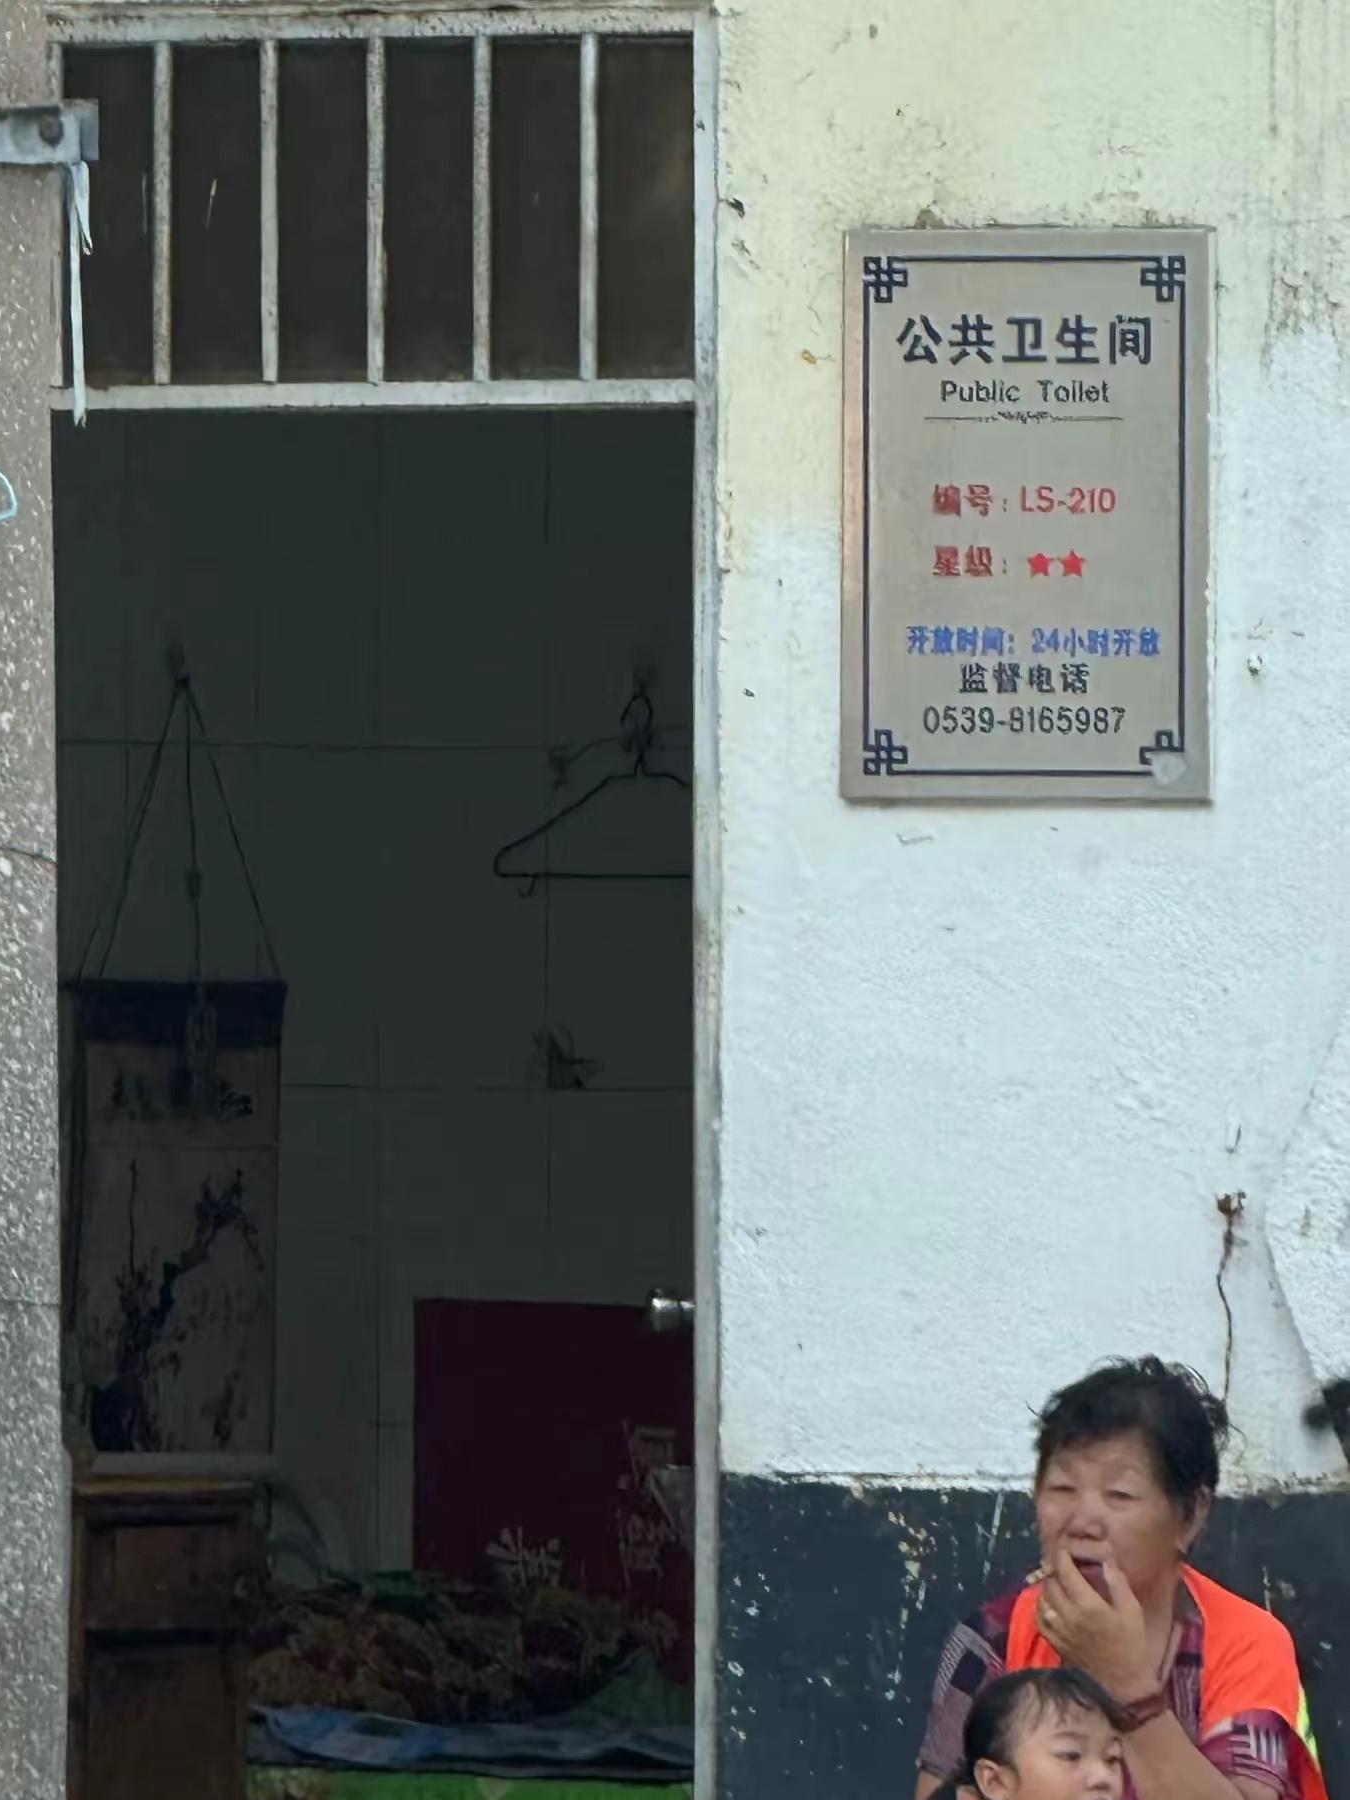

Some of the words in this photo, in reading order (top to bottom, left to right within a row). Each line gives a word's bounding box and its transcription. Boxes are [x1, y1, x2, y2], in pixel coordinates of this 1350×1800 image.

[896, 314, 1152, 366] 公共卫生间
[940, 379, 1021, 403] Public
[1036, 379, 1111, 403] Toilet
[959, 661, 1091, 694] 监督电话
[923, 706, 1126, 735] 0539-8165987
